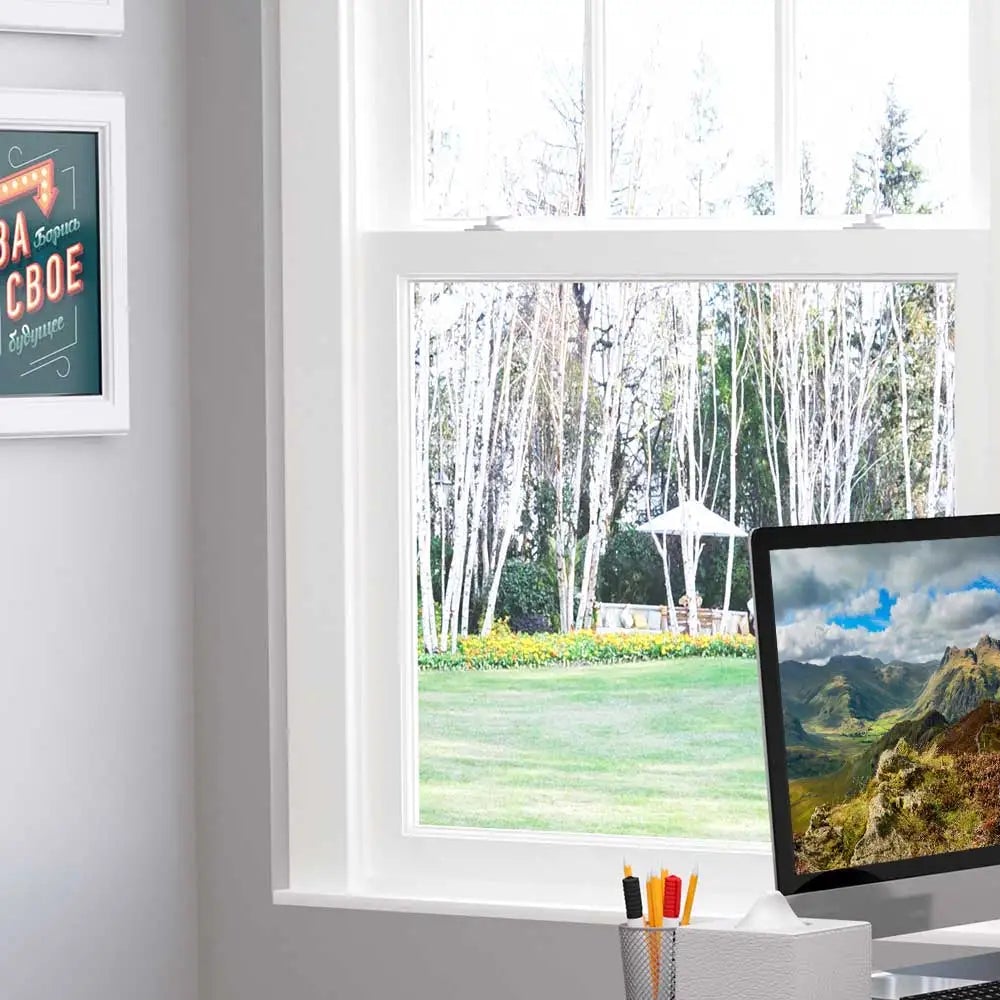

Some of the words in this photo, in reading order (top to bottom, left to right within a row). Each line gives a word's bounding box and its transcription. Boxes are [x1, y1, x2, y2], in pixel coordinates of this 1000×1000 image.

[33, 217, 81, 249] Борись
[6, 241, 85, 322] СВОЕ
[8, 315, 65, 356] будущее
